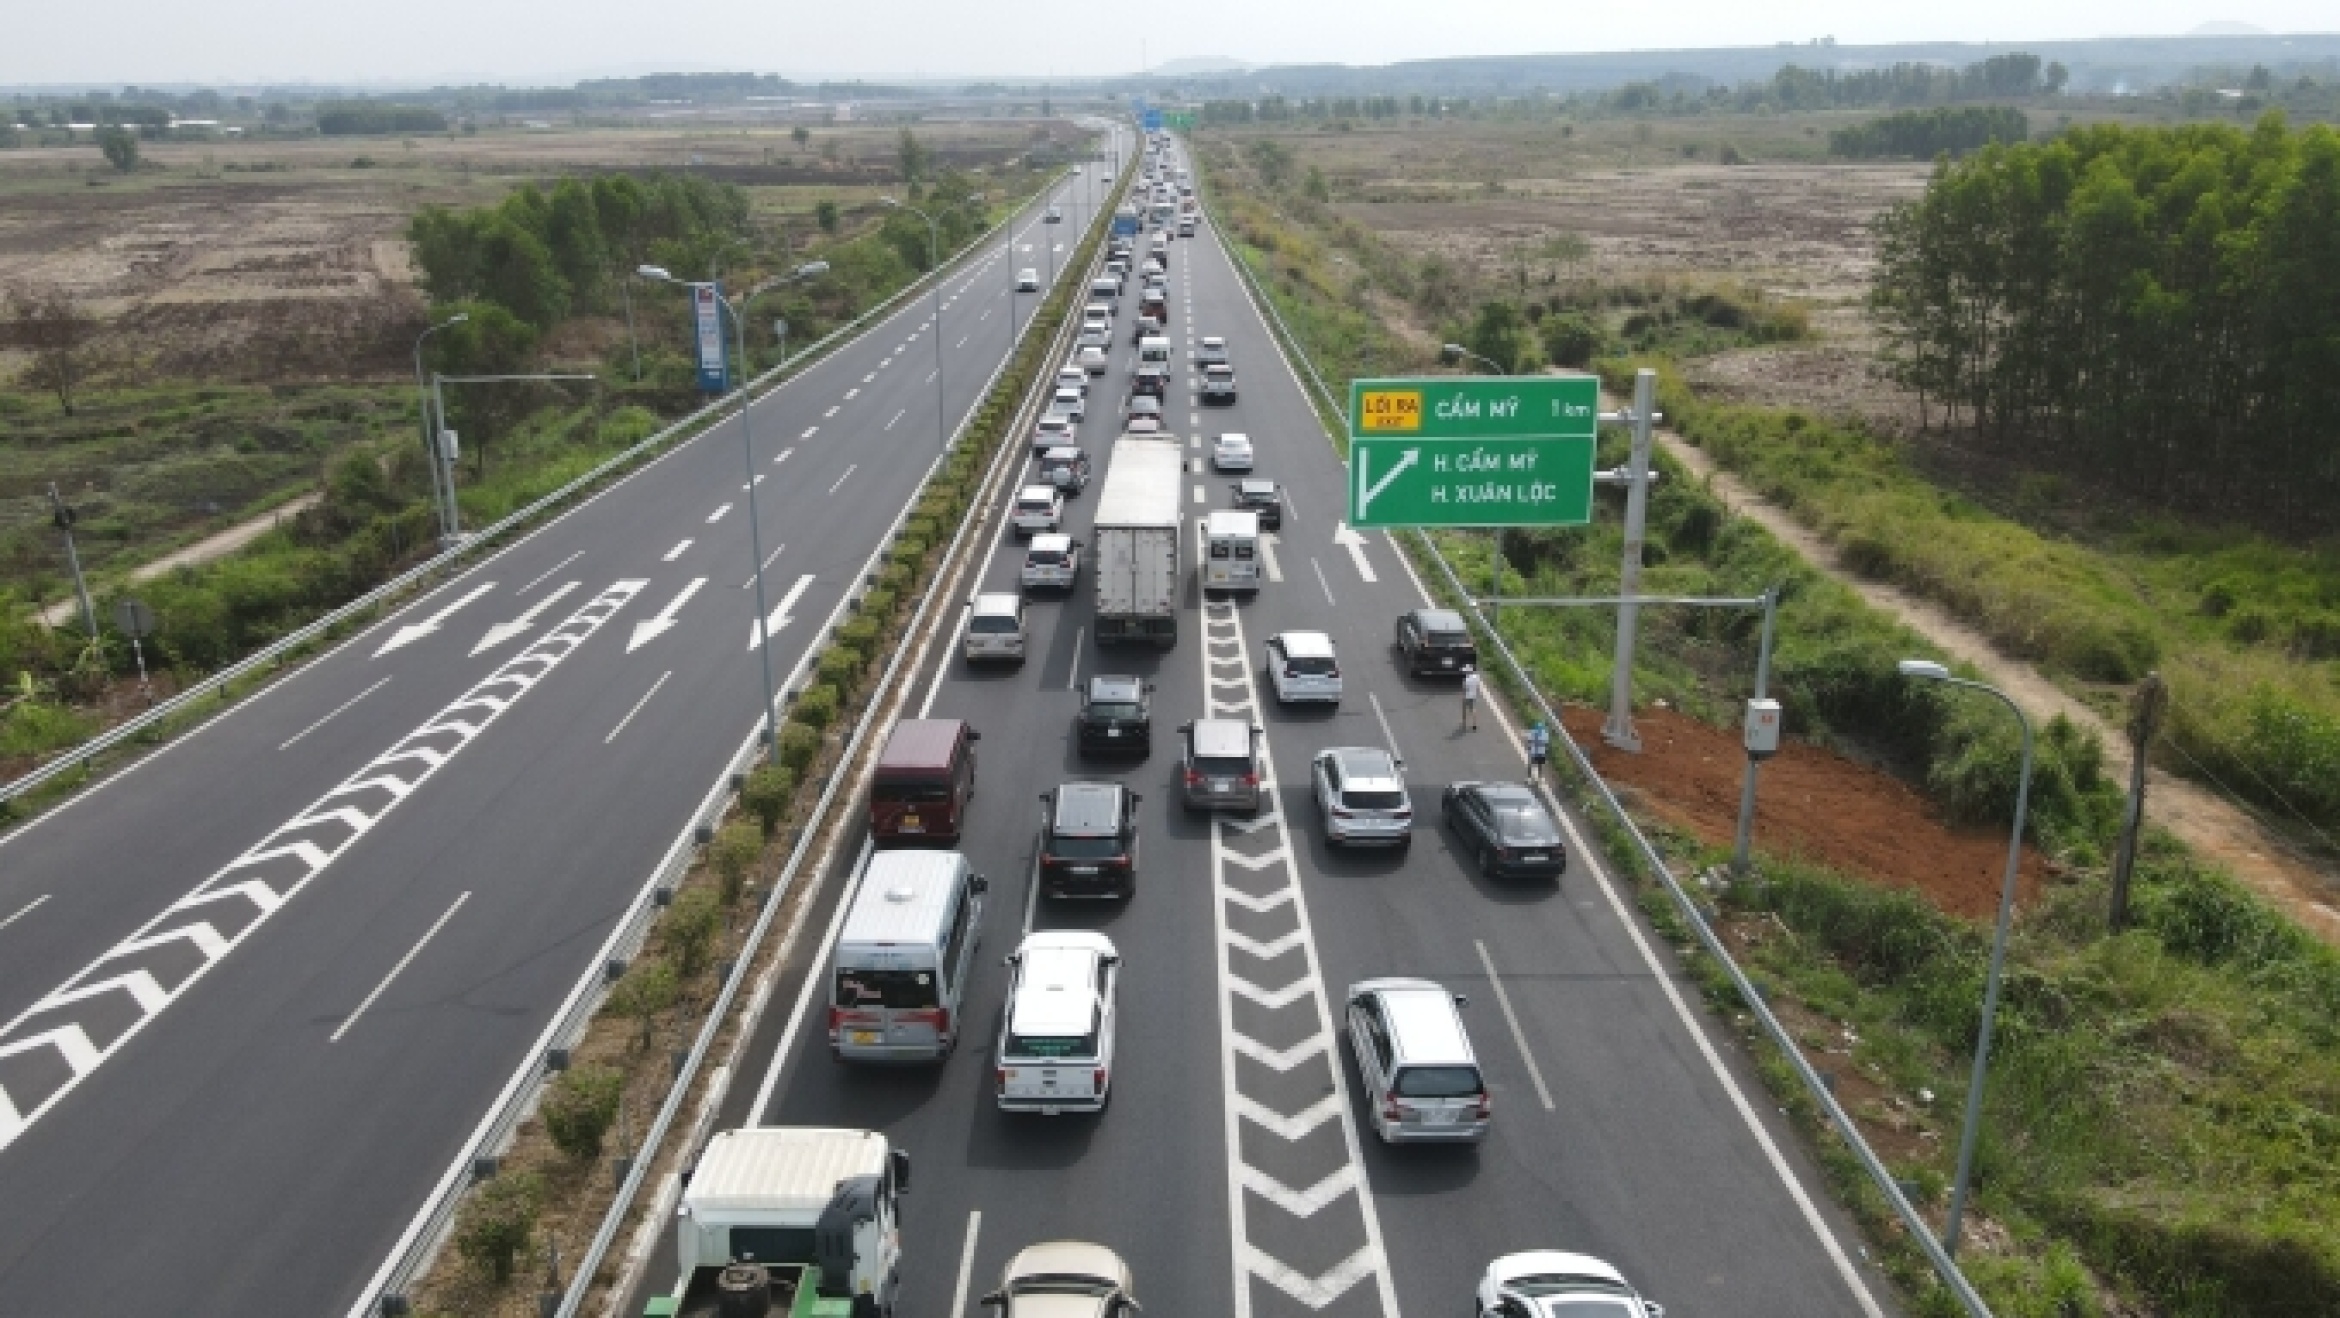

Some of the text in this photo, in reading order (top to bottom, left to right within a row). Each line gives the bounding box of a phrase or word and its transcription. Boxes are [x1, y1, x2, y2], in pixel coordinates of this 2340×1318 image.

[1562, 400, 1590, 417] km
[1431, 479, 1556, 505] H. XUÂN LỘC
